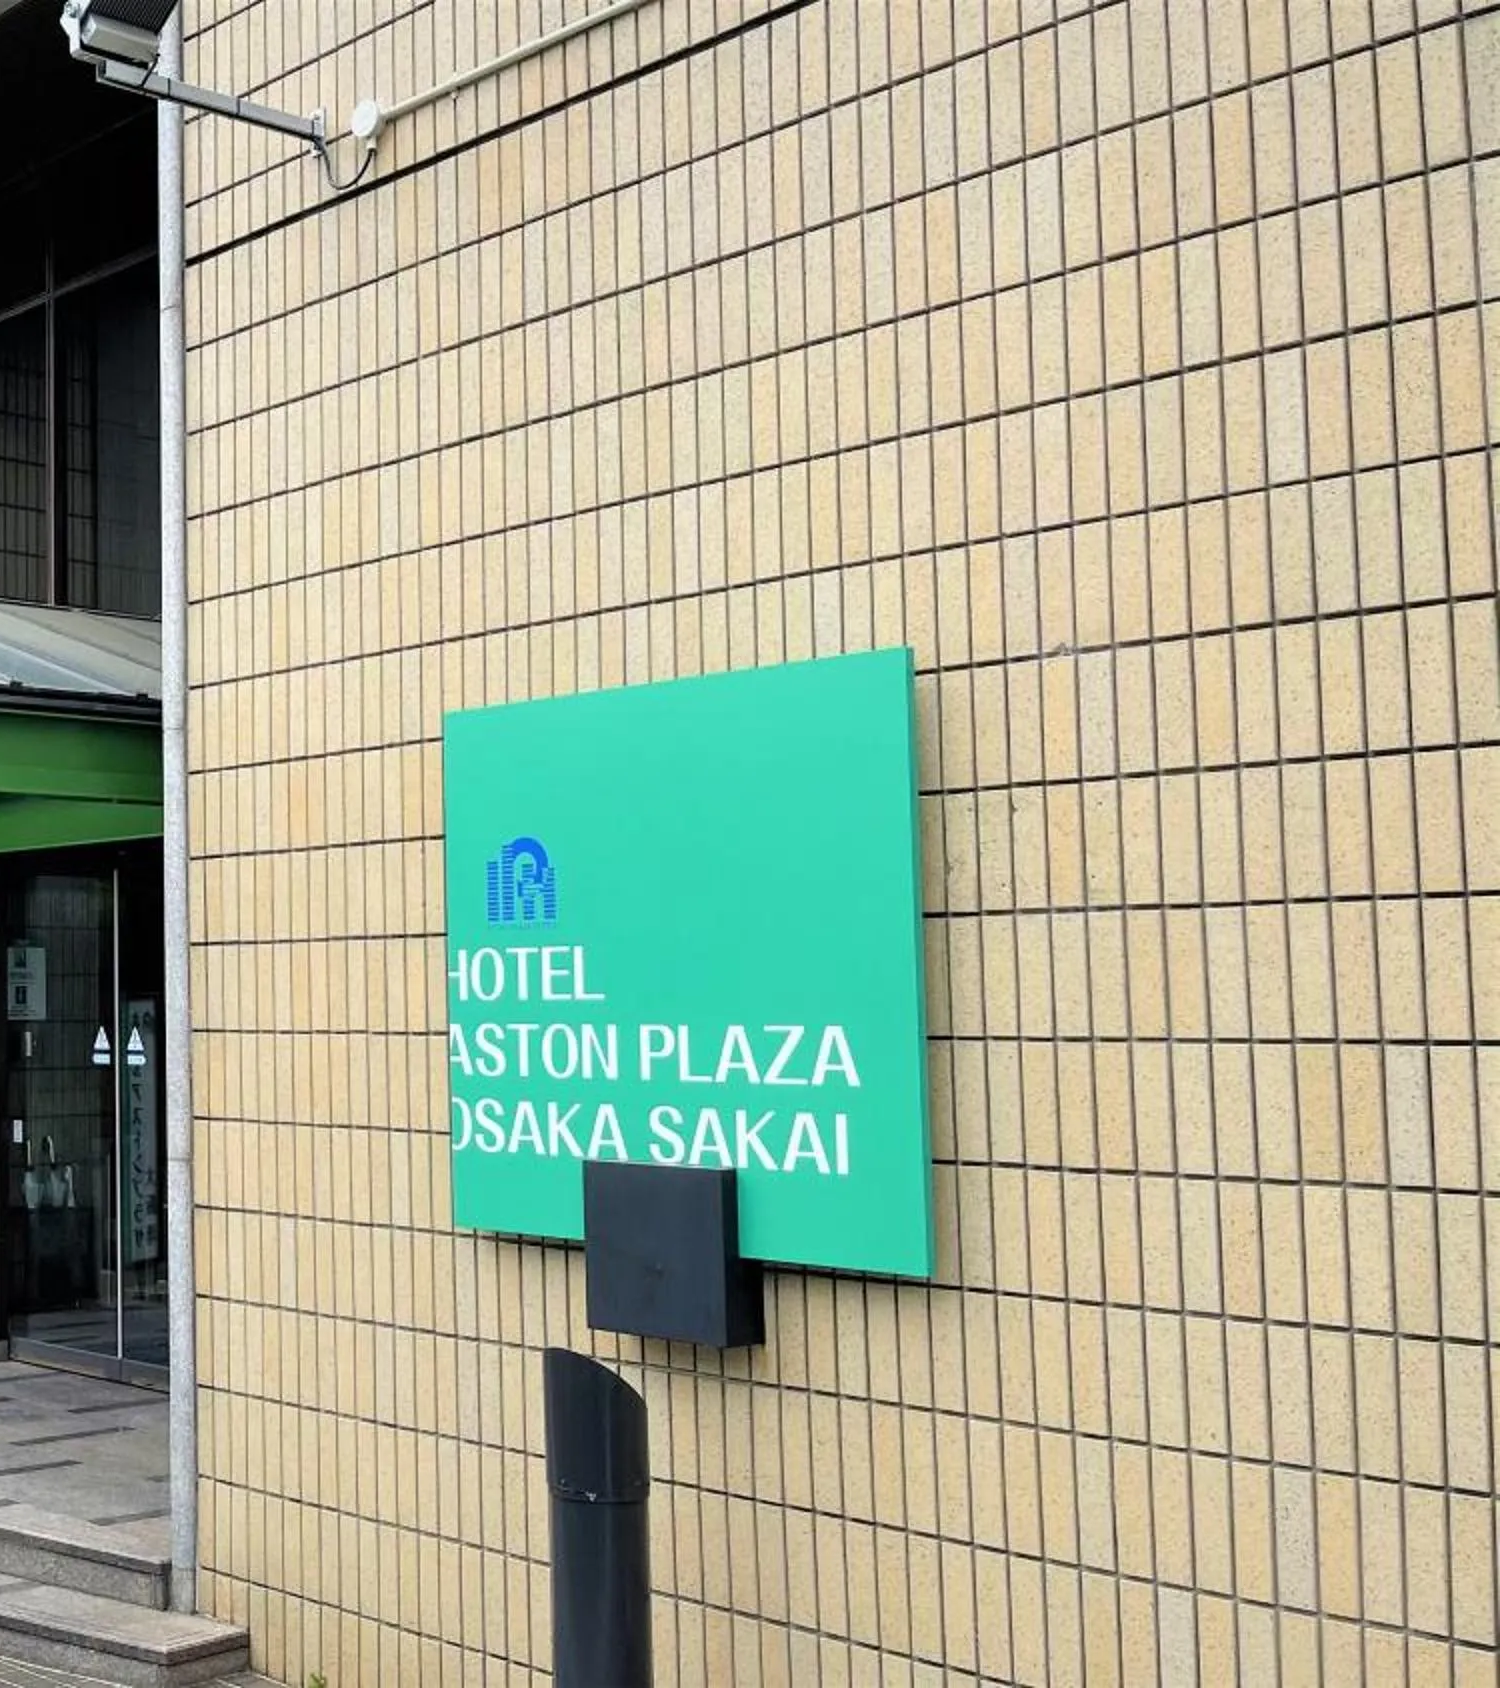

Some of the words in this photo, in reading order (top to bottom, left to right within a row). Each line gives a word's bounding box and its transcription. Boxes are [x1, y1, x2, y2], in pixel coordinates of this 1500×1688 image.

[450, 1023, 619, 1080] ASTON
[639, 1024, 861, 1088] PLAZA
[648, 1104, 850, 1176] SAKAI
